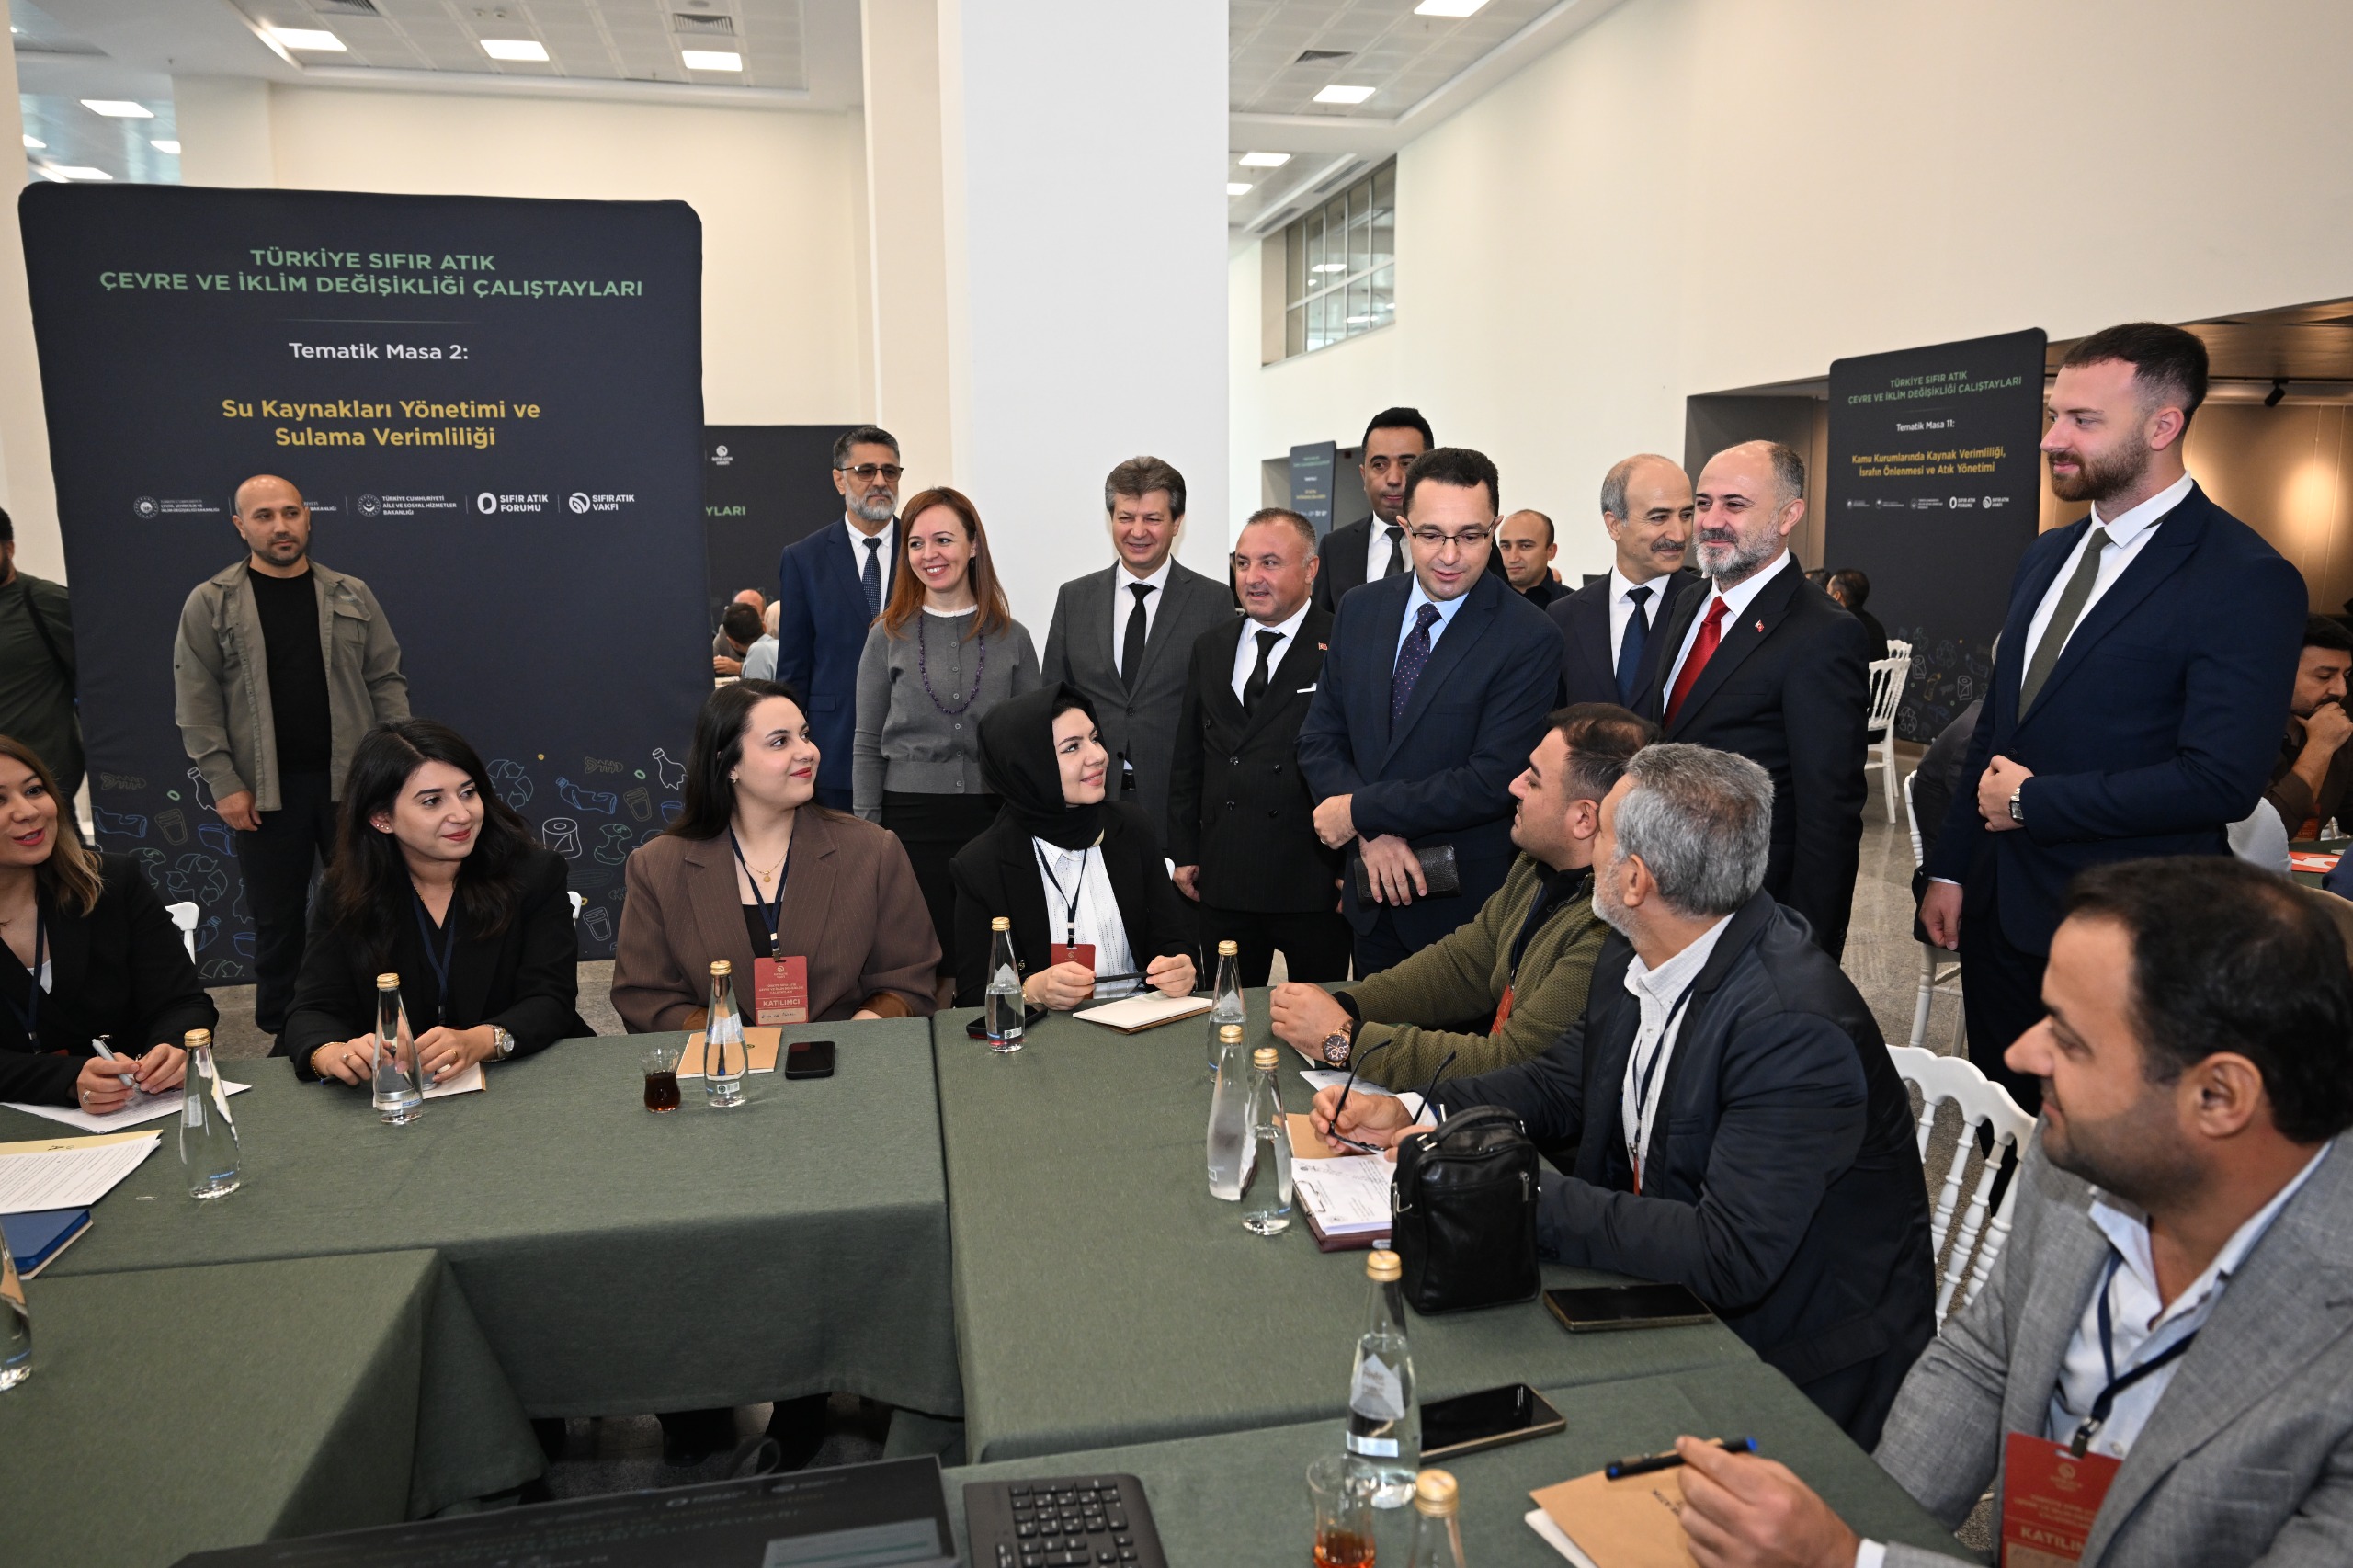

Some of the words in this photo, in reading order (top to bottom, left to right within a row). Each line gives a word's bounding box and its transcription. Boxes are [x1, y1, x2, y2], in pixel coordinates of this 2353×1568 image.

[250, 246, 361, 268] TÜRKİYE
[369, 253, 432, 269] SIFIR
[440, 255, 496, 271] ATIK
[99, 272, 188, 291] ÇEVRE
[195, 274, 231, 290] VE
[238, 271, 308, 292] İKLİM
[316, 274, 465, 297] DEĞİŞİKLİĞİ
[473, 279, 642, 299] ÇALIŞTAYLARI
[288, 342, 380, 359] Tematik
[386, 344, 442, 359] Masa
[449, 345, 469, 360] 2:
[1890, 376, 1924, 388] TÜRKİYE
[1925, 373, 1946, 384] SIFIR
[1948, 370, 1967, 381] ATIK
[1848, 394, 1872, 404] ÇEVRE
[1873, 392, 1884, 402] VE
[1885, 390, 1906, 401] İKLİM
[1907, 382, 1956, 398] DEĞİŞİKLİĞİ
[1958, 376, 2022, 394] ÇALIŞTAYLARI
[221, 399, 253, 417] Su
[261, 399, 392, 422] Kaynakları
[398, 400, 506, 418] Yönetimi
[513, 403, 540, 418] ve
[1896, 421, 1924, 432] Tematik
[1926, 420, 1945, 430] Masa
[1946, 419, 1955, 428] 11:
[275, 426, 366, 446] Sulama
[372, 427, 495, 449] Verimliliği
[1851, 454, 1872, 464] Kamu
[1874, 451, 1925, 463] Kurumlarında
[1927, 449, 1957, 462] Kaynak
[1883, 464, 1924, 476] Önlenmesi
[1926, 467, 1936, 475] ve
[1937, 464, 1954, 474] Atık
[1957, 461, 1995, 473] Yönetimi
[499, 494, 525, 503] SIFIR
[527, 494, 549, 503] ATIK
[592, 494, 615, 503] SIFIR
[615, 494, 635, 503] ATIK
[500, 504, 541, 512] FORUMU
[593, 503, 619, 511] VAKFI
[763, 998, 801, 1006] KATILIMCI
